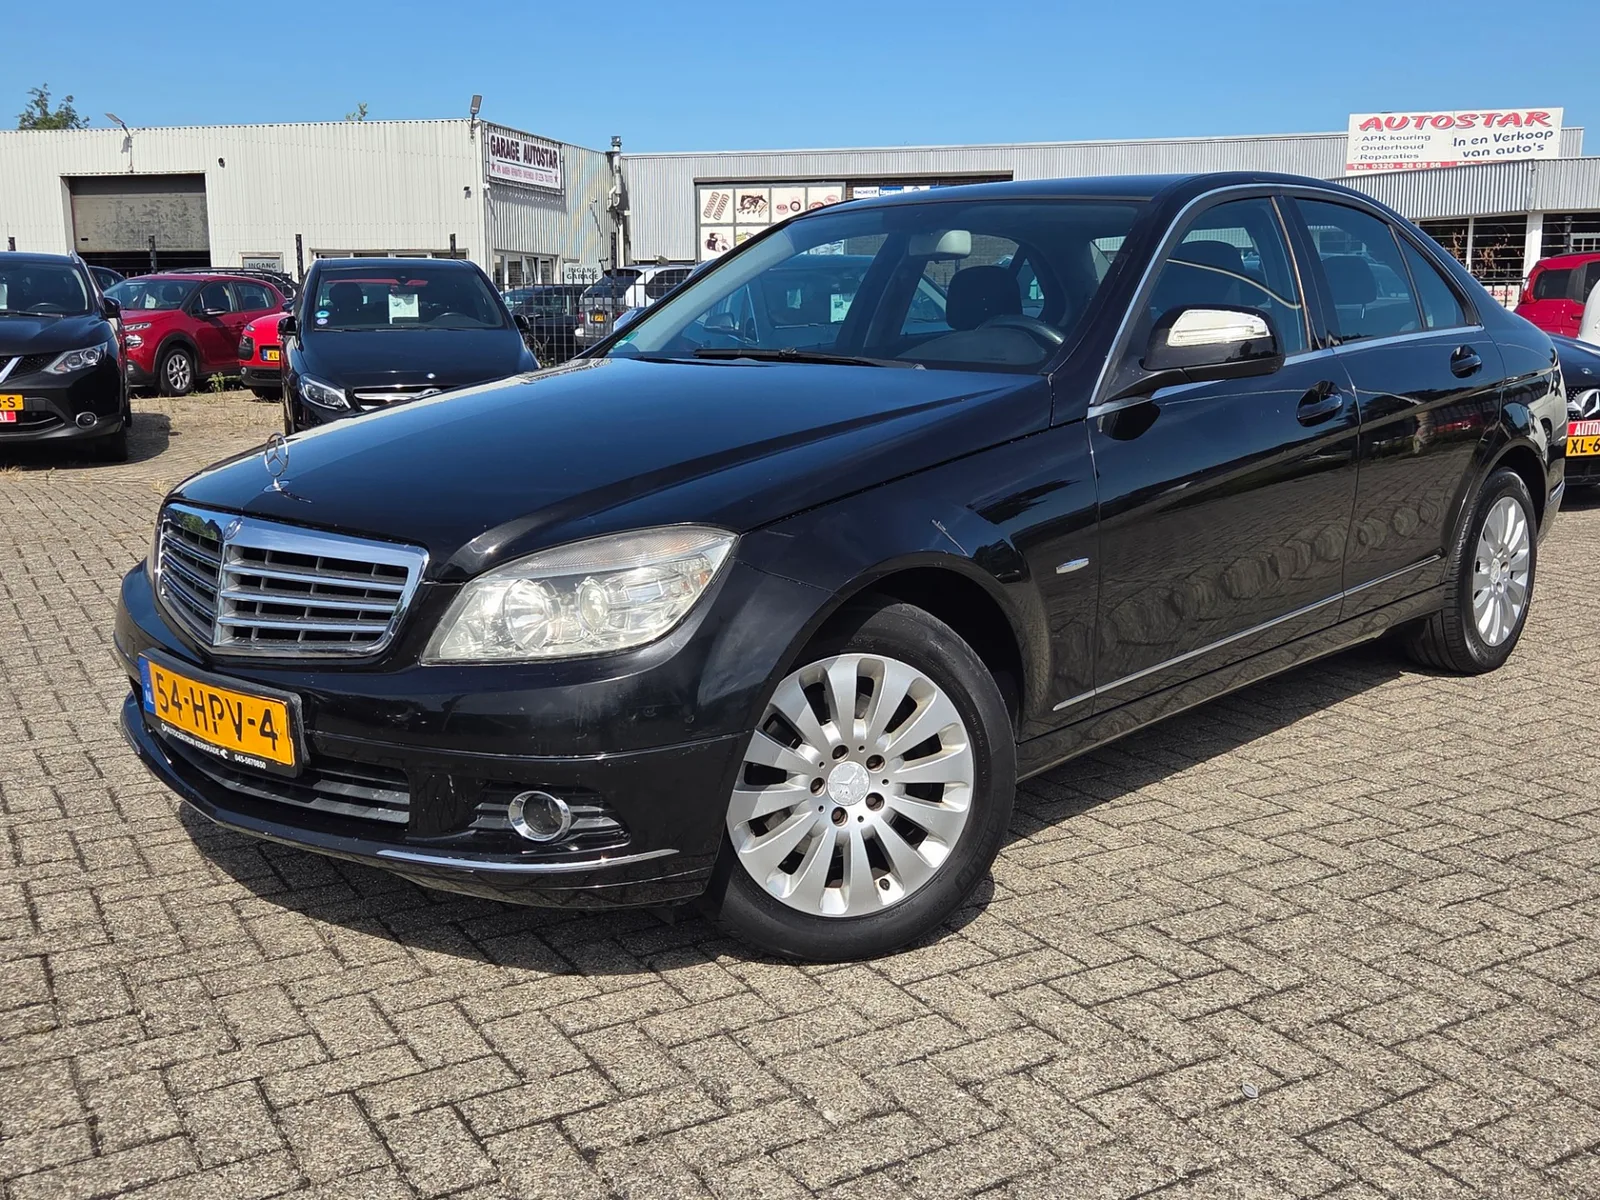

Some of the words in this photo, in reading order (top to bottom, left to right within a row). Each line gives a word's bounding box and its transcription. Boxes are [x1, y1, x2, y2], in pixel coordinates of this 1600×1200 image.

[1359, 112, 1552, 131] AUTOSTAR
[1453, 137, 1466, 147] In
[1471, 137, 1488, 145] en
[1493, 130, 1554, 143] Verkoop
[490, 135, 520, 162] GARAGE
[523, 142, 559, 170] AUTOSTAR
[1359, 153, 1420, 161] Reparaties
[1462, 149, 1490, 158] van
[1495, 142, 1545, 155] auto's
[156, 672, 278, 751] 54-HPV-4
